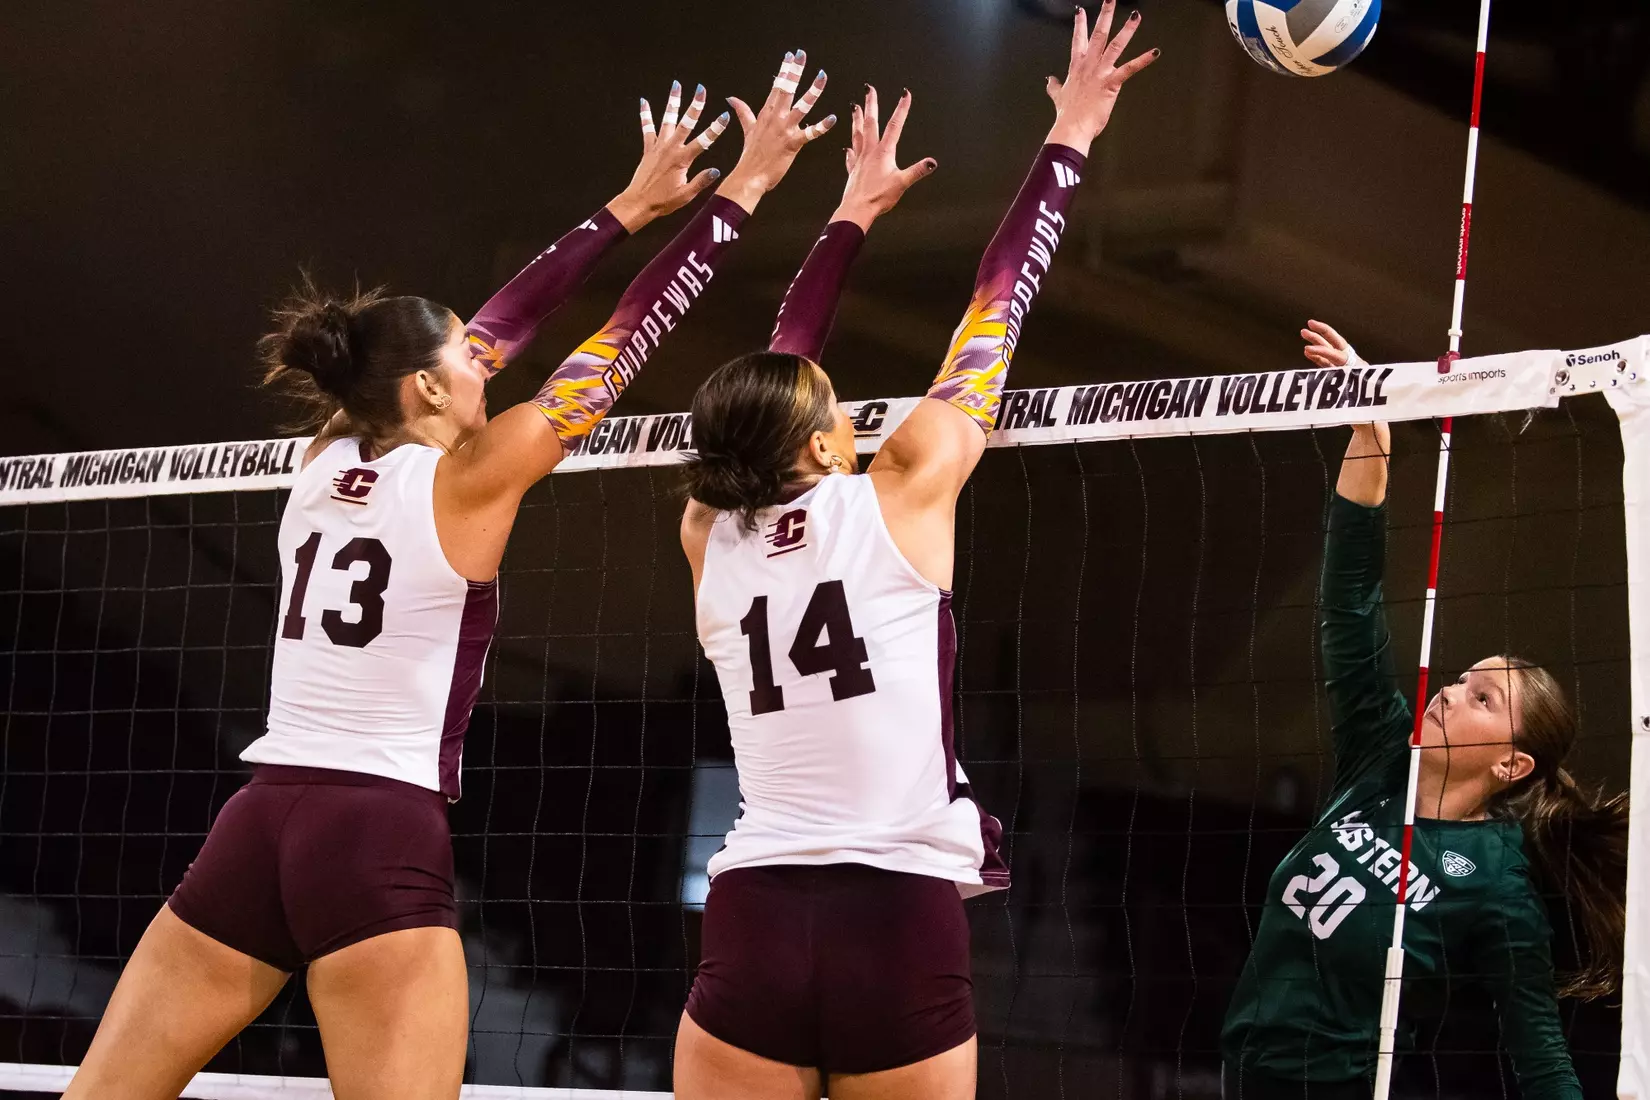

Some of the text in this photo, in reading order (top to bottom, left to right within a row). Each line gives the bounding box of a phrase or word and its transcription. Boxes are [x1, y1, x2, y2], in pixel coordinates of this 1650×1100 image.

[1265, 25, 1293, 59] Touch
[602, 251, 714, 402] CHIPPEWAS
[1438, 368, 1506, 385] sports imports
[1577, 349, 1620, 366] Senoh
[1065, 377, 1214, 427] MICHIGAN
[1215, 367, 1394, 417] VOLLEYBALL
[573, 414, 694, 456] IGAN VOL
[59, 450, 167, 488] MICHIGAN
[168, 440, 297, 481] VOLLEYBALL
[281, 531, 392, 649] 13
[739, 579, 876, 716] 14
[1281, 852, 1366, 940] 20
